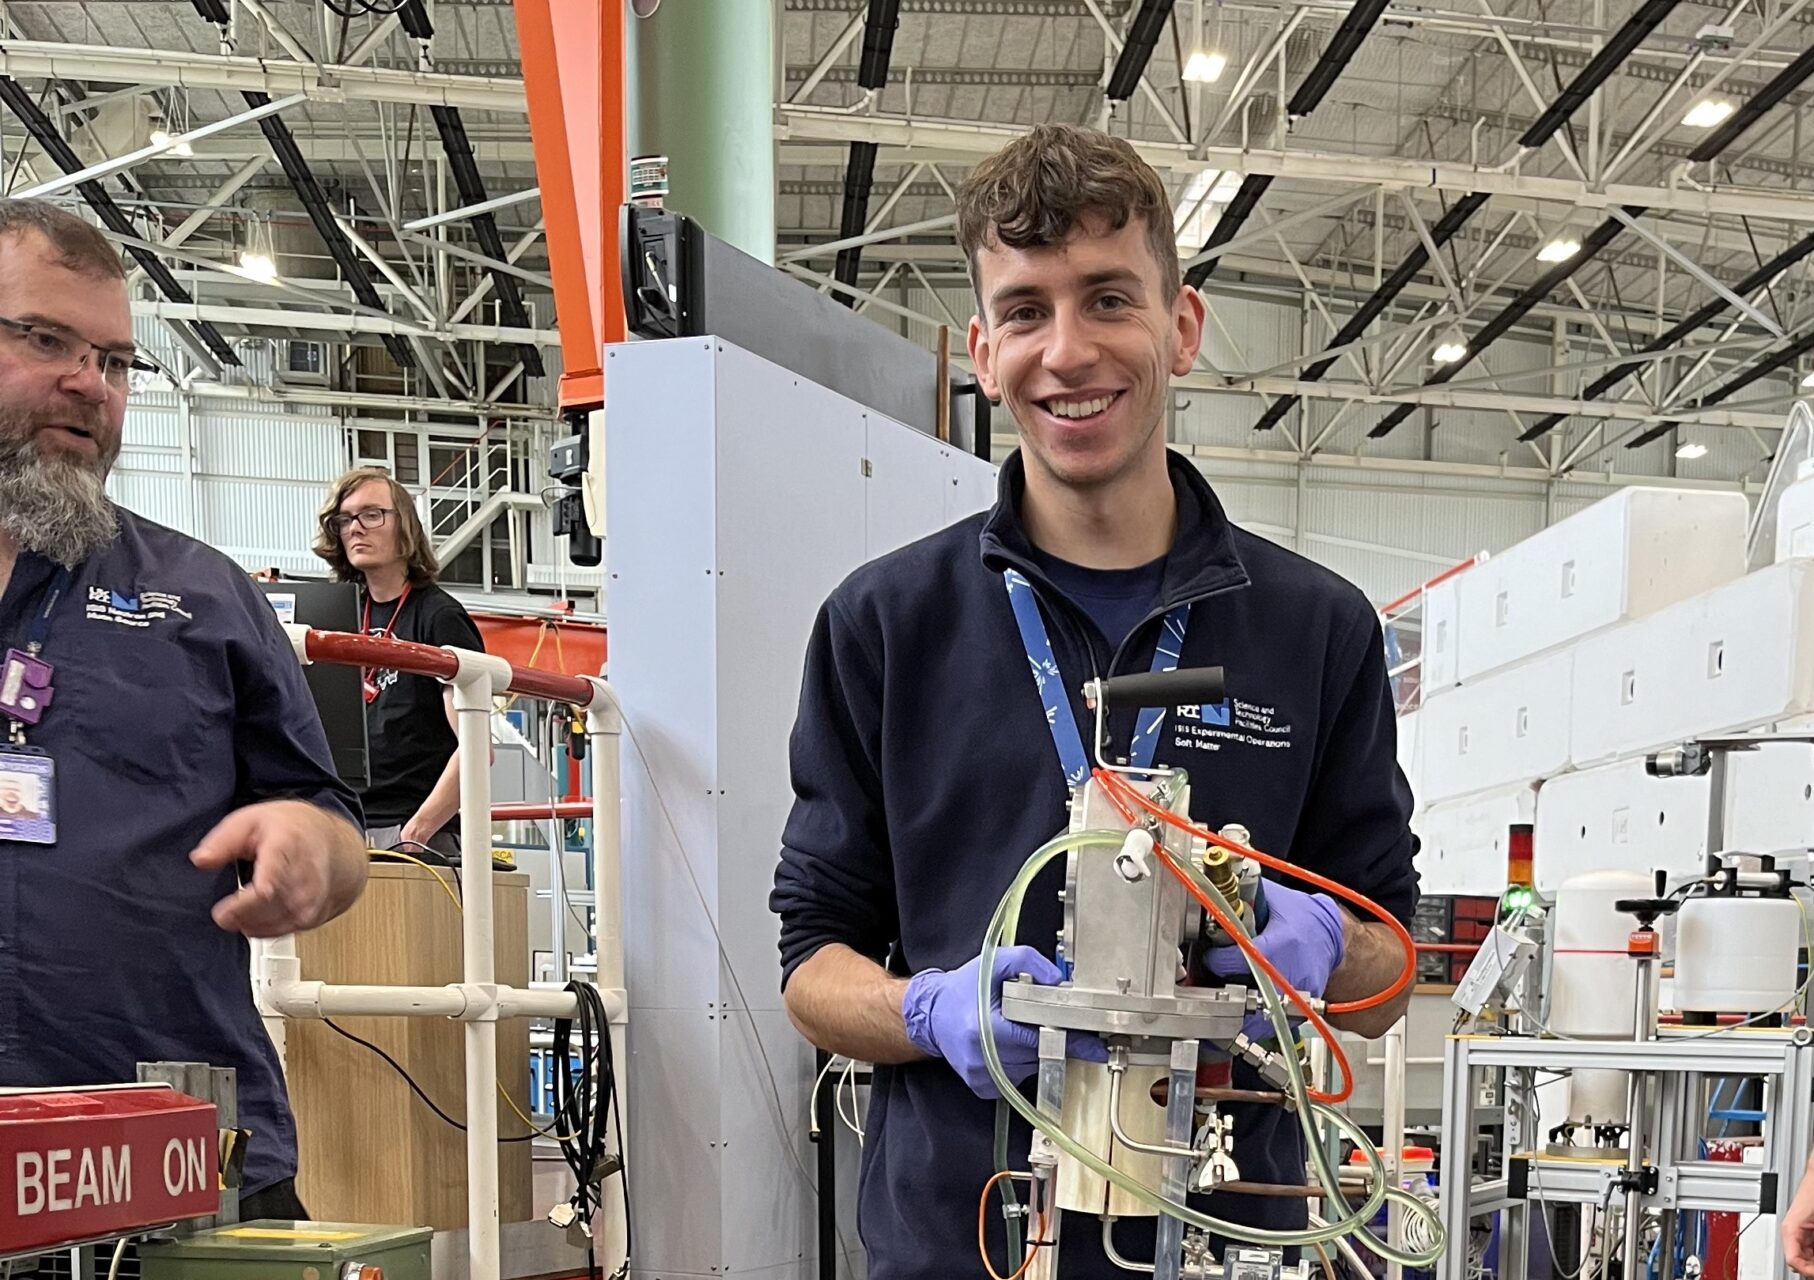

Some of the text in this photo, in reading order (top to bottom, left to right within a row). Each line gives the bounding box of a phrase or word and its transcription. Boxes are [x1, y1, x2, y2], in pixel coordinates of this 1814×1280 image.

[1261, 706, 1275, 715] and
[1264, 724, 1291, 733] Council
[1175, 737, 1192, 748] Soft
[16, 1136, 206, 1215] BEAM ON
